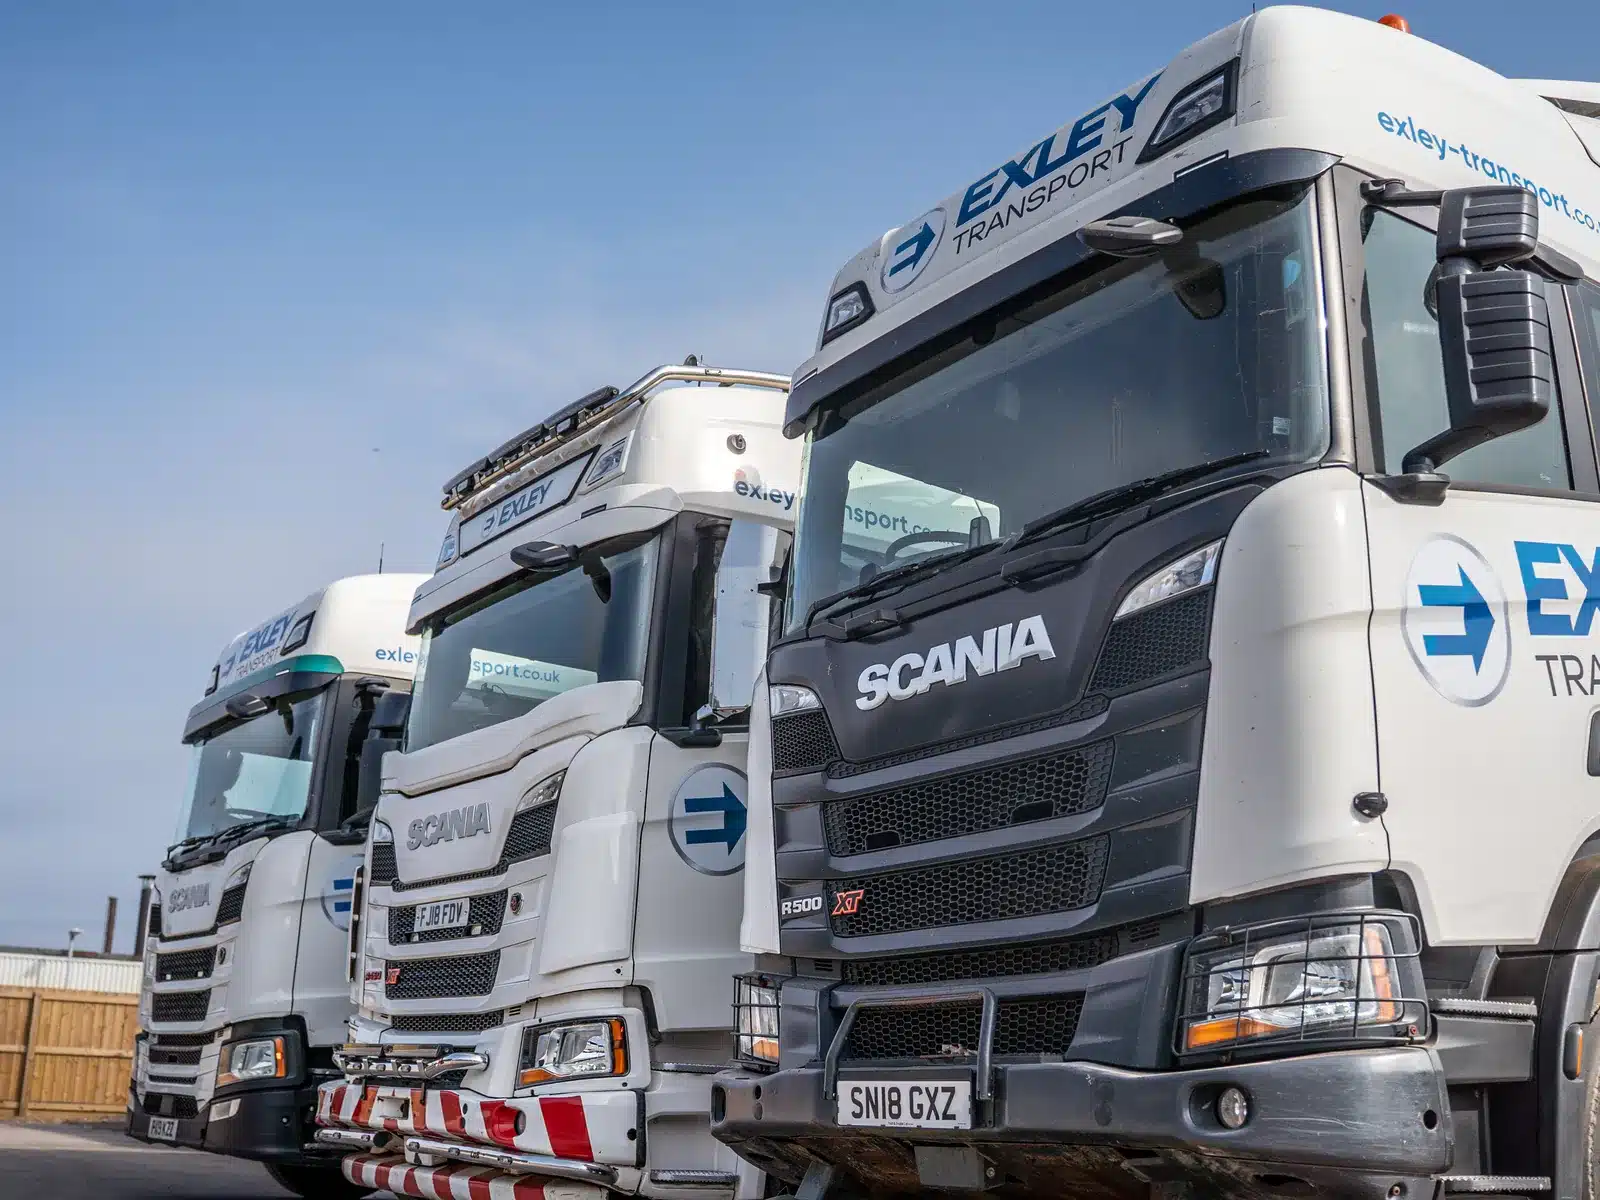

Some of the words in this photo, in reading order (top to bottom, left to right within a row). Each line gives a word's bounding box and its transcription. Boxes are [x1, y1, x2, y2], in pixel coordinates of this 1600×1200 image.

[955, 68, 1166, 229] EXLEY
[953, 136, 1133, 255] TRANSPORT
[1377, 111, 1600, 234] exley-transport.co.
[498, 480, 555, 527] EXLEY
[240, 609, 299, 663] EXLEY
[375, 646, 418, 663] exle
[472, 660, 560, 683] sport.co.uk
[855, 614, 1056, 711] SCANIA
[407, 802, 492, 851] SCANIA
[168, 883, 210, 913] SCANIA
[420, 905, 440, 927] FJ18
[442, 902, 463, 924] FDV
[781, 896, 823, 915] R500
[832, 889, 865, 915] XT
[851, 1086, 901, 1119] SN18
[909, 1086, 956, 1120] GXZ
